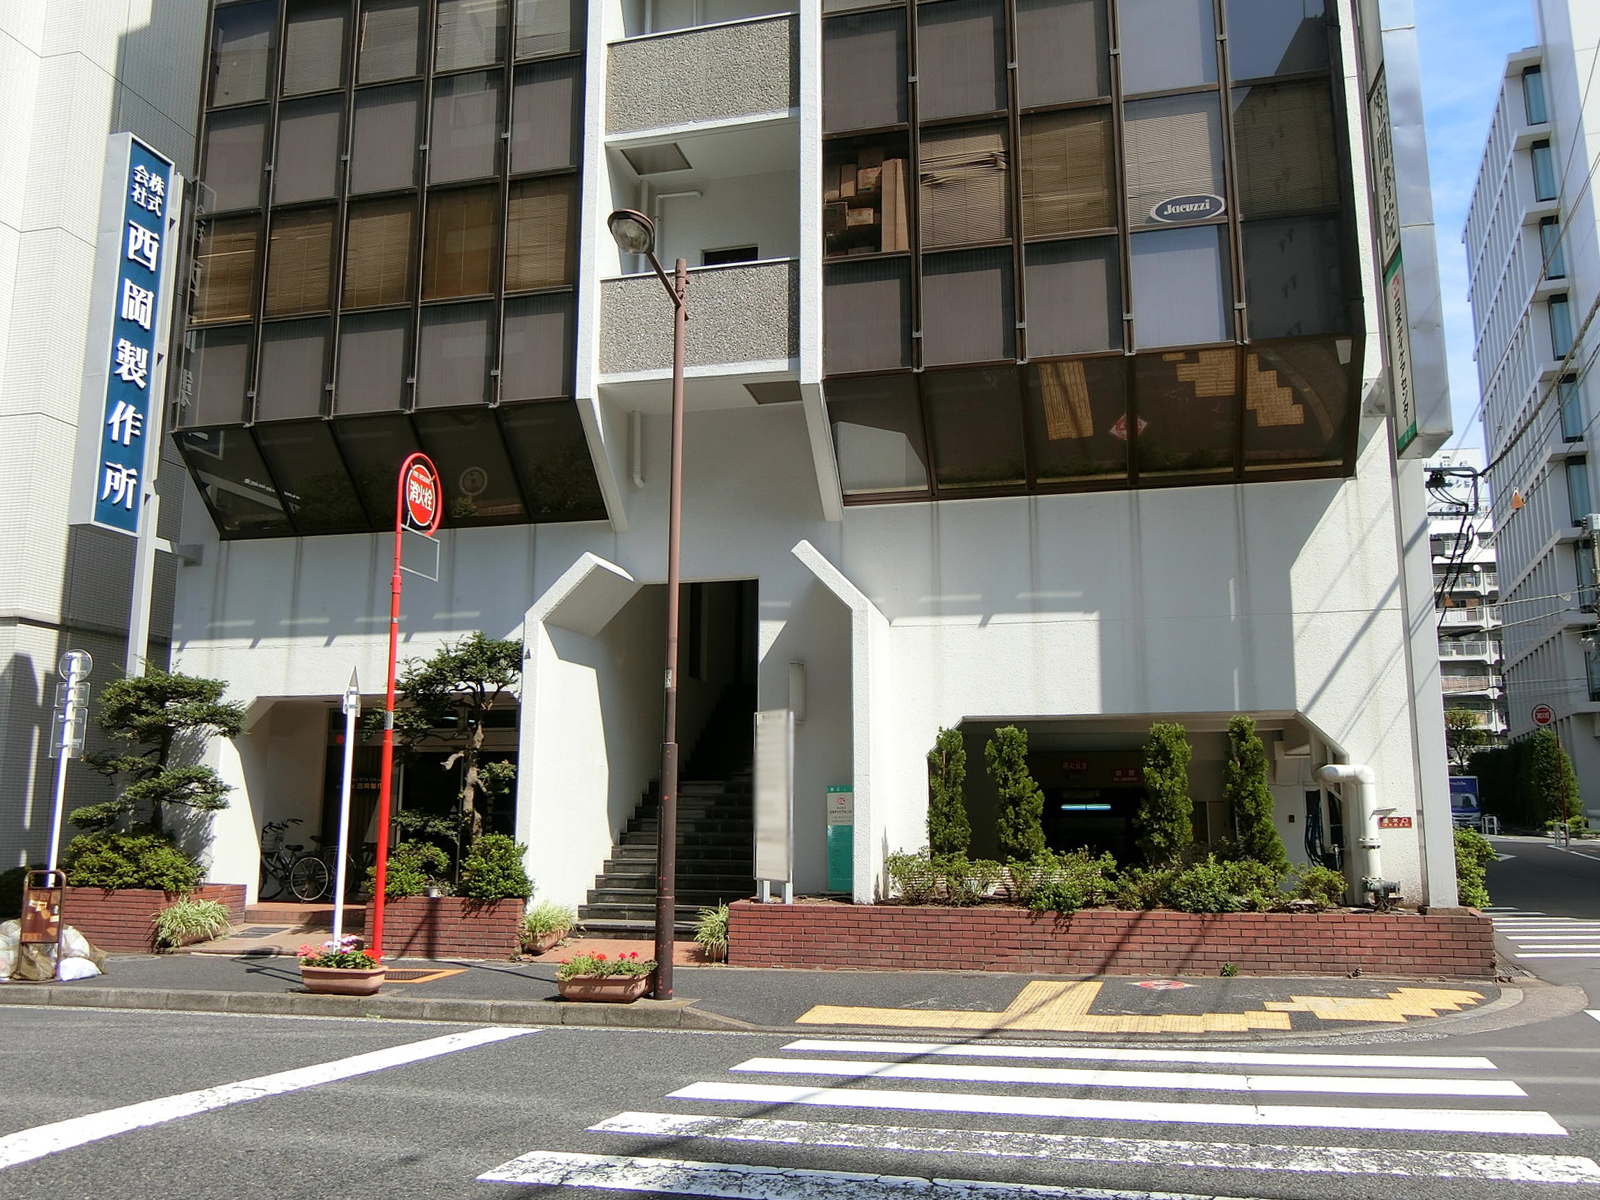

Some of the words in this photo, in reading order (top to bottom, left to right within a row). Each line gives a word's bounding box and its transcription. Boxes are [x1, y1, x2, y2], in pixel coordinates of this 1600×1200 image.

[1164, 199, 1210, 215] Jacuzzi
[102, 221, 160, 510] 西岡製作所
[409, 479, 433, 511] 消火栓
